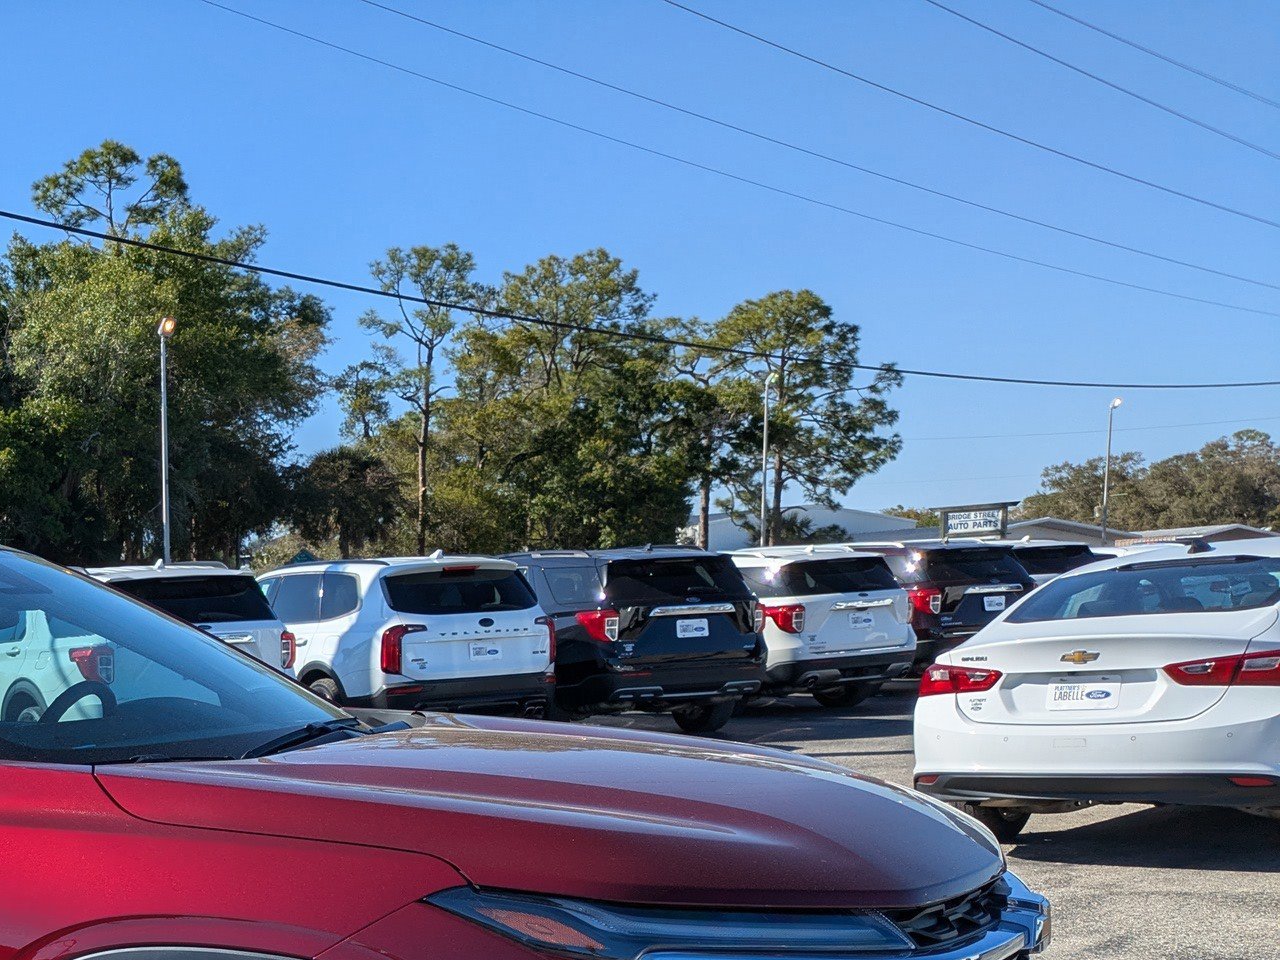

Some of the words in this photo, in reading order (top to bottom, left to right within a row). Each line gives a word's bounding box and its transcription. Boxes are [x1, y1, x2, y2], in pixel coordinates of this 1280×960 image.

[947, 512, 972, 520] BRIDGE
[973, 510, 999, 519] STREET
[948, 522, 969, 531] AUTO
[972, 520, 999, 529] PARTS
[1053, 690, 1085, 701] LABELLE
